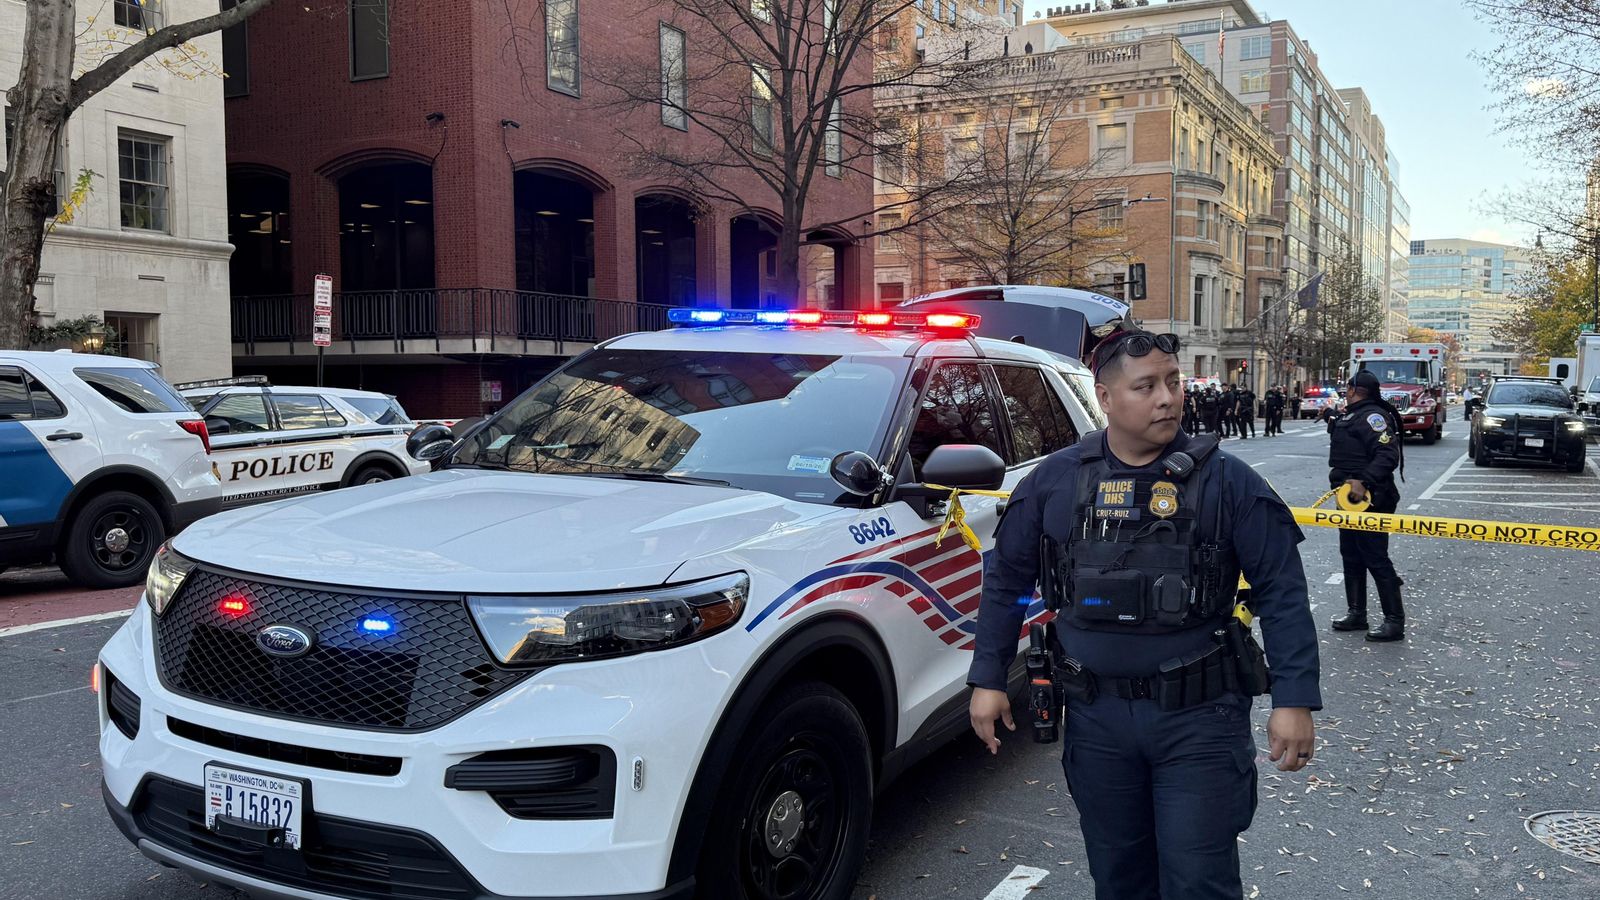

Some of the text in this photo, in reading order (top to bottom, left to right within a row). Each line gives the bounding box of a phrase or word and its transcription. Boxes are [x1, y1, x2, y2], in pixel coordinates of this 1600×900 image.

[1091, 294, 1124, 309] SOD
[229, 451, 334, 481] POLICE
[240, 491, 265, 499] STATES
[294, 484, 320, 492] SERVICE
[1099, 481, 1133, 493] POLICE
[1104, 493, 1125, 505] DHS
[1096, 509, 1129, 518] CRUZ-RUIZ
[848, 516, 896, 545] 8642
[1315, 512, 1600, 543] POLICE LINE DO NOT CRO
[267, 631, 296, 649] Ford
[229, 773, 268, 789] WASHINGTON,
[269, 781, 278, 790] DC
[239, 790, 293, 832] 15832
